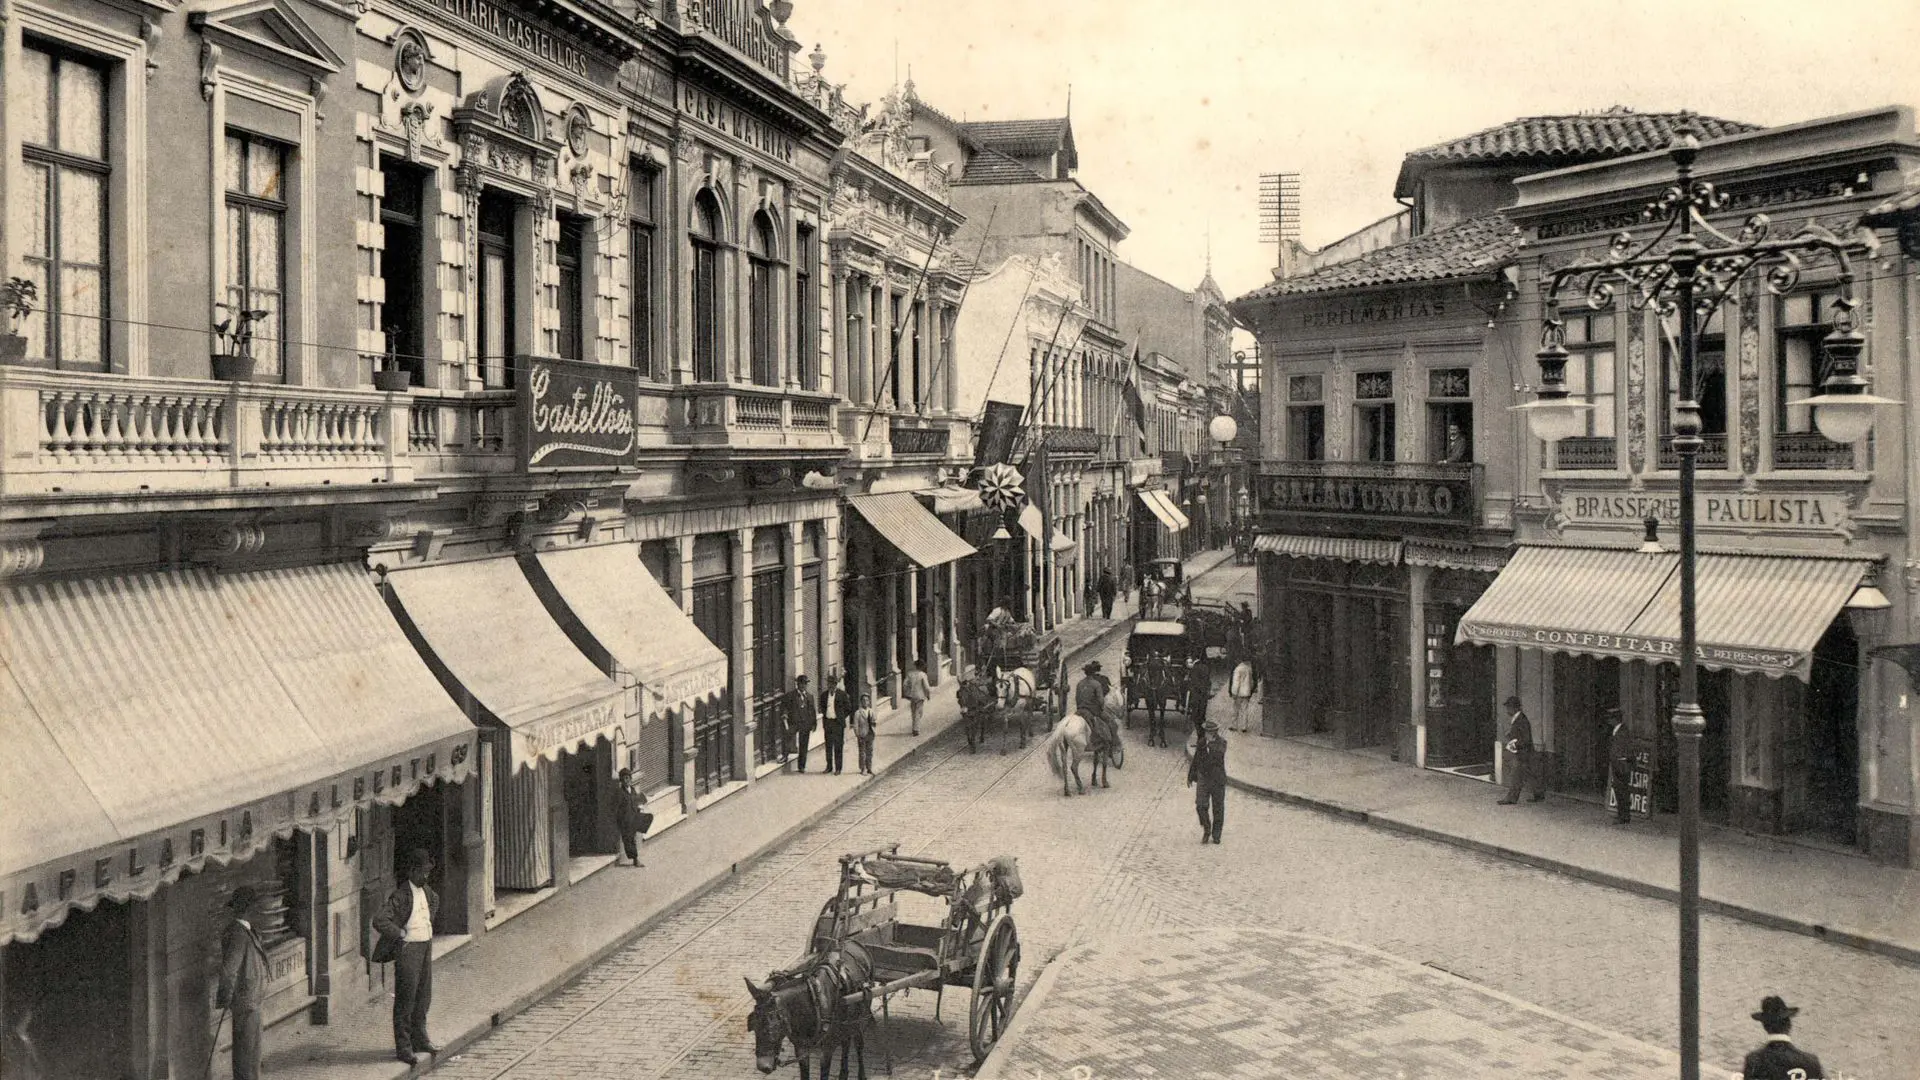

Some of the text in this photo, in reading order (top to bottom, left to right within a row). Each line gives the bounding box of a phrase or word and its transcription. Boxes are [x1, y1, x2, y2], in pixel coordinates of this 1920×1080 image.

[685, 82, 793, 163] CASA MATHIAS
[530, 364, 634, 436] Castellões
[1575, 496, 1826, 525] BRASSERIE PAULISTA
[1535, 630, 1707, 658] CONFEITARA
[1783, 653, 1794, 667] 3
[0, 811, 253, 918] APELARIA
[308, 752, 437, 817] ALBERTO
